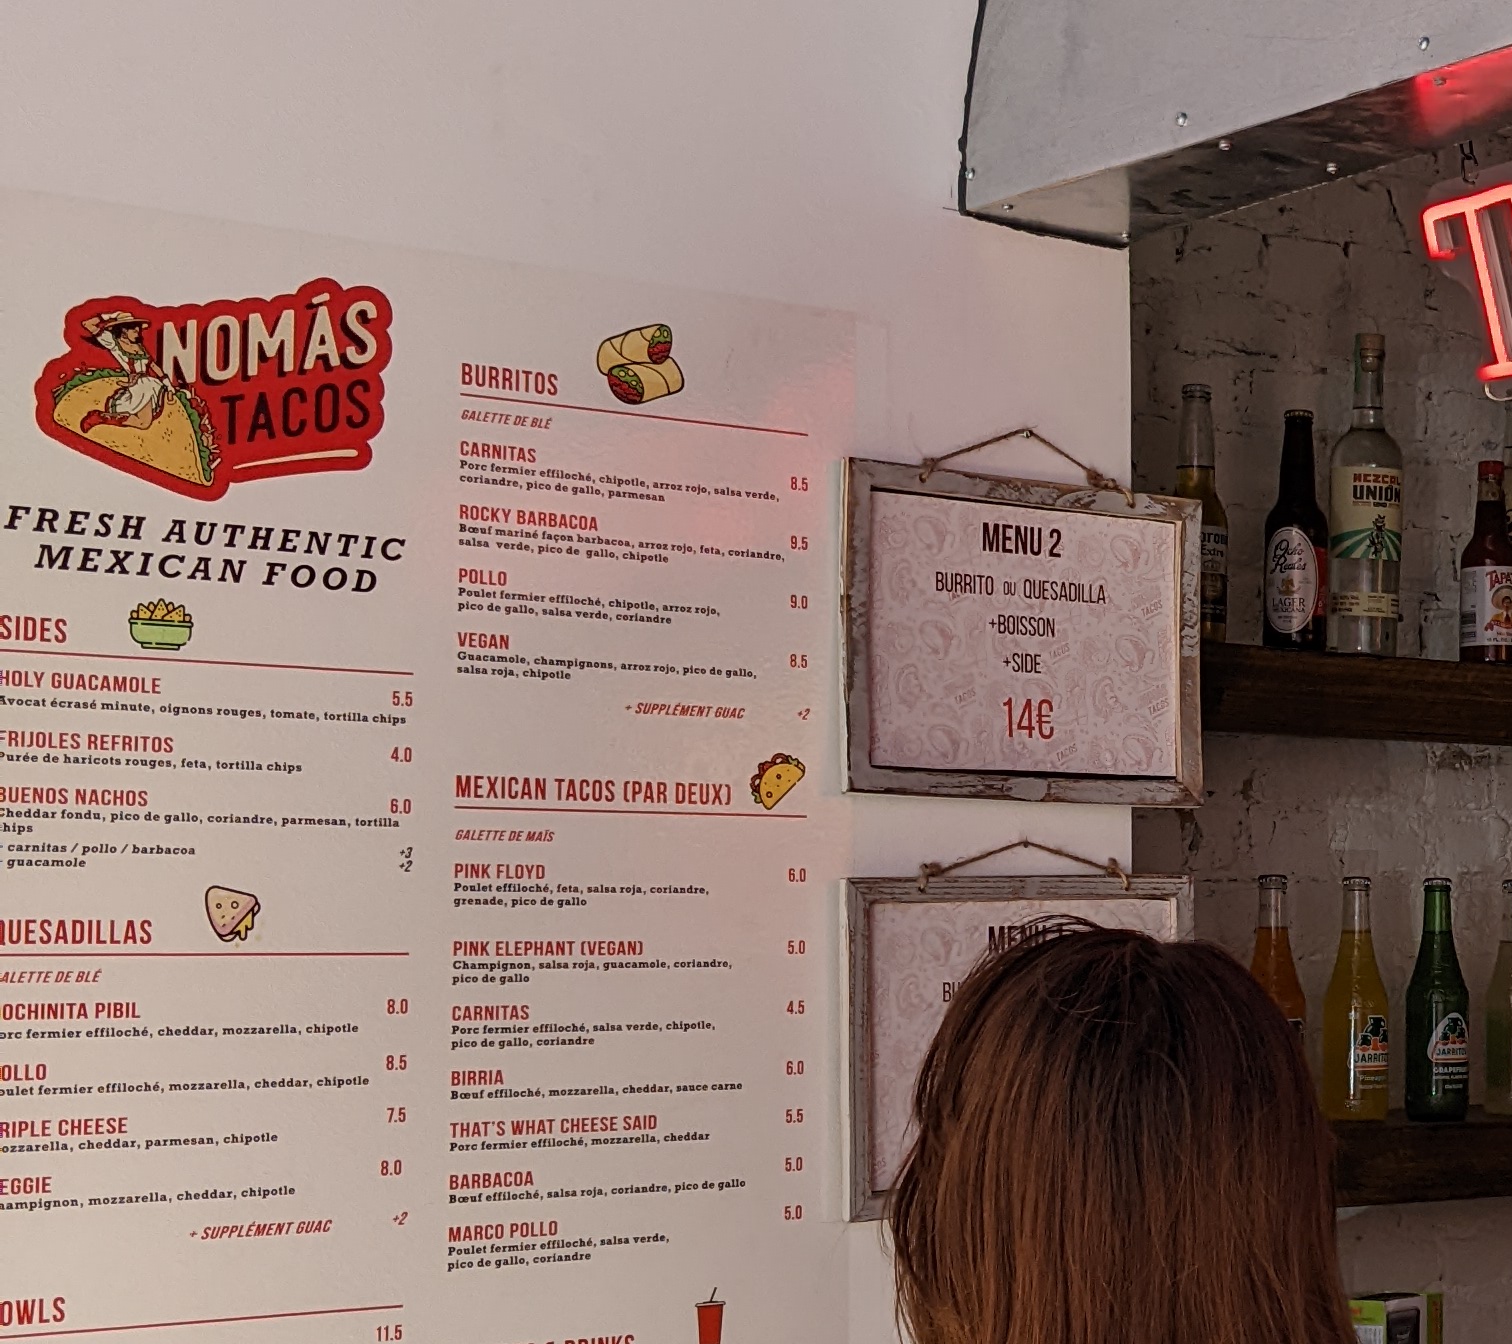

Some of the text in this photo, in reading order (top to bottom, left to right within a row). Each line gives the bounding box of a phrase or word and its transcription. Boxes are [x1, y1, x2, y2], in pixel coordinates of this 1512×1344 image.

[160, 293, 378, 383] NOMÁS
[462, 363, 558, 396] BURRITOS
[222, 380, 370, 444] TACOS
[461, 409, 552, 429] GALETTE DE BLÉ
[460, 441, 536, 463] CARNITAS
[791, 476, 808, 492] 8.5
[1352, 484, 1401, 503] UNIÓN
[460, 504, 598, 531] ROCKY BARBACOA
[4, 505, 406, 561] FRESH AUTHENTIC
[982, 522, 1061, 558] MENU 2
[791, 535, 808, 550] 9.5
[34, 544, 377, 592] MEXICAN FOOD
[459, 568, 507, 586] POLLO
[936, 571, 994, 597] BURRITO
[1023, 579, 1106, 604] QUESADILLA
[790, 594, 808, 609] 9.0
[1272, 597, 1305, 607] LAGER
[0, 615, 67, 643] SIDES
[989, 614, 1055, 638] +BOISSON
[458, 632, 509, 650] VEGAN
[790, 654, 807, 668] 8.5
[1003, 653, 1041, 674] +SIDE
[51, 672, 161, 694] GUACAMOLE
[392, 691, 413, 707] 5.5
[50, 698, 97, 709] écrasé
[101, 701, 155, 714] minute,
[160, 703, 213, 716] oignons
[217, 708, 266, 719] rouges,
[270, 709, 319, 722] tomate,
[324, 712, 369, 722] tortilla
[372, 714, 406, 726] chips
[635, 702, 745, 719] SUPPLÉMENT GUAC
[1003, 697, 1054, 739] 14€
[88, 734, 173, 753] REFRITOS
[391, 747, 412, 762] 4.0
[75, 789, 148, 807] NACHOS
[456, 775, 731, 805] MEXICAN TACOS (PAR DEUX)
[390, 798, 411, 814] 6.0
[455, 829, 555, 842] GALETTE DE MAÏS
[454, 863, 545, 879] PINK FLOYD
[788, 868, 806, 882] 6.0
[453, 941, 643, 956] PINK ELEPHANT (VEGAN)
[788, 940, 805, 954] 5.0
[54, 969, 102, 983] DE BLÉ
[95, 1002, 140, 1019] PIBIL
[387, 998, 408, 1014] 8.0
[452, 1005, 529, 1021] CARNITAS
[787, 1000, 805, 1015] 4.5
[386, 1055, 407, 1070] 8.5
[786, 1060, 804, 1075] 6.0
[451, 1070, 504, 1086] BIRRIA
[387, 1107, 406, 1123] 7.5
[786, 1108, 803, 1123] 5.5
[58, 1117, 128, 1136] CHEESE
[450, 1115, 657, 1138] THAT'S WHAT CHEESE SAID
[381, 1159, 402, 1176] 8.0
[785, 1157, 803, 1172] 5.0
[449, 1171, 534, 1190] BARBACOA
[393, 1211, 408, 1225] +2
[784, 1205, 802, 1220] 5.0
[201, 1219, 332, 1240] SUPPLÉMENT GUAC
[449, 1220, 558, 1242] MARCO POLLO
[377, 1324, 402, 1342] 11.5
